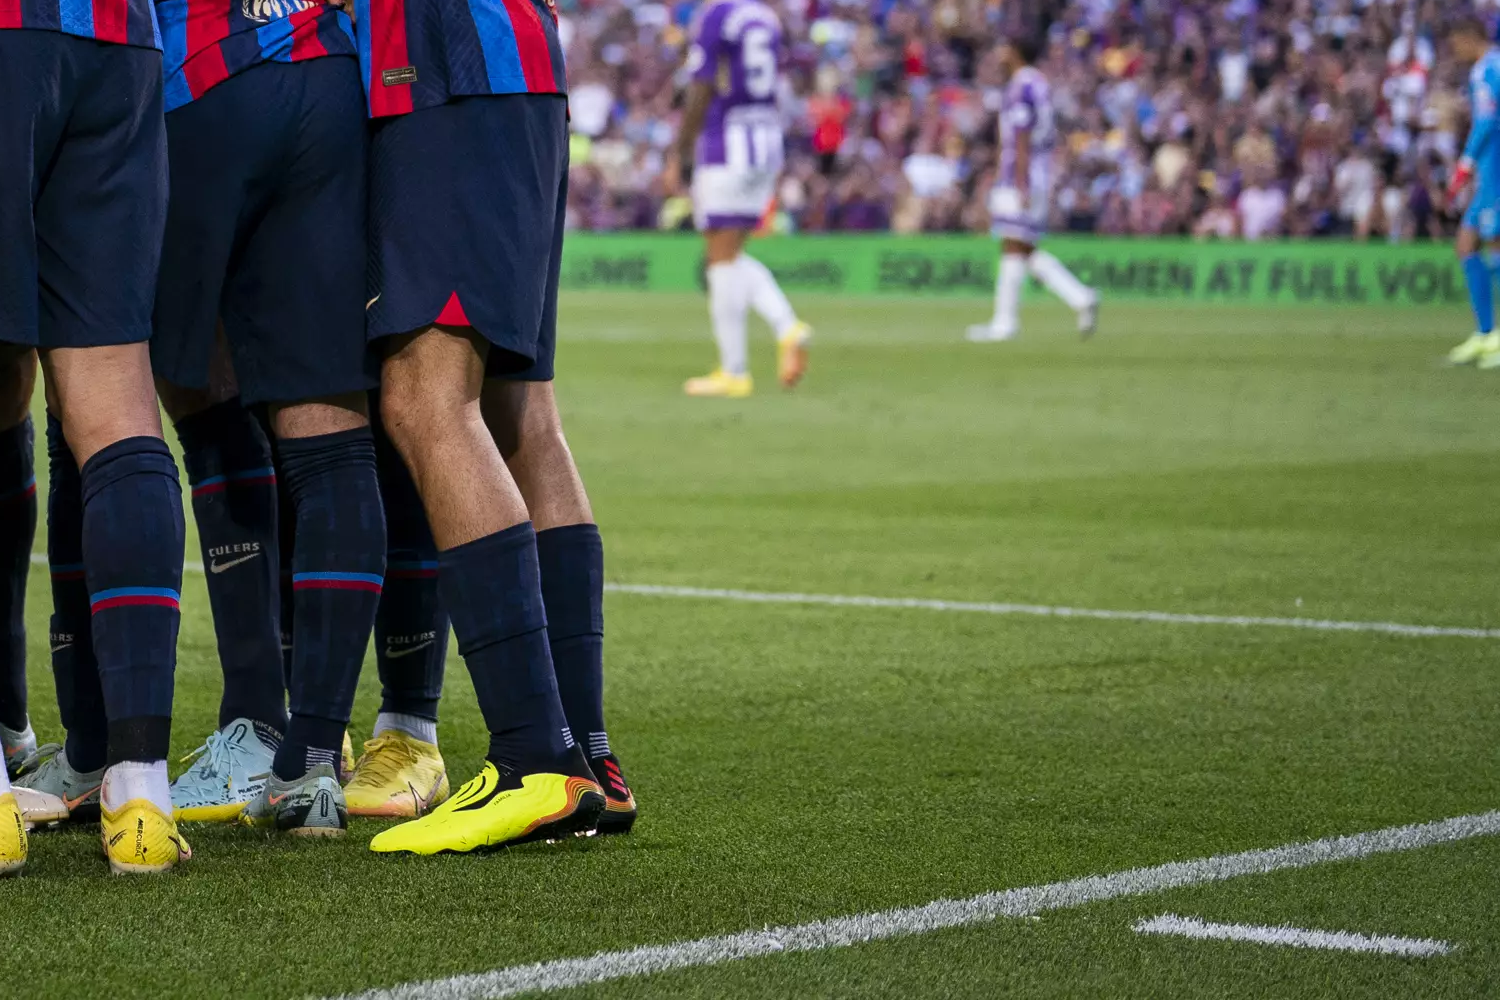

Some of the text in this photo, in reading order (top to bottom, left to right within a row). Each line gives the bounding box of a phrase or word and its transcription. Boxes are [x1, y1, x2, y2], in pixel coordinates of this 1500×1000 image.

[744, 28, 777, 97] 5
[1206, 257, 1257, 297] AT
[1268, 258, 1368, 301] FULL
[1376, 260, 1468, 303] VOL
[208, 542, 260, 557] CULERS
[387, 631, 436, 644] CULERS
[135, 817, 144, 858] MERCURIAL
